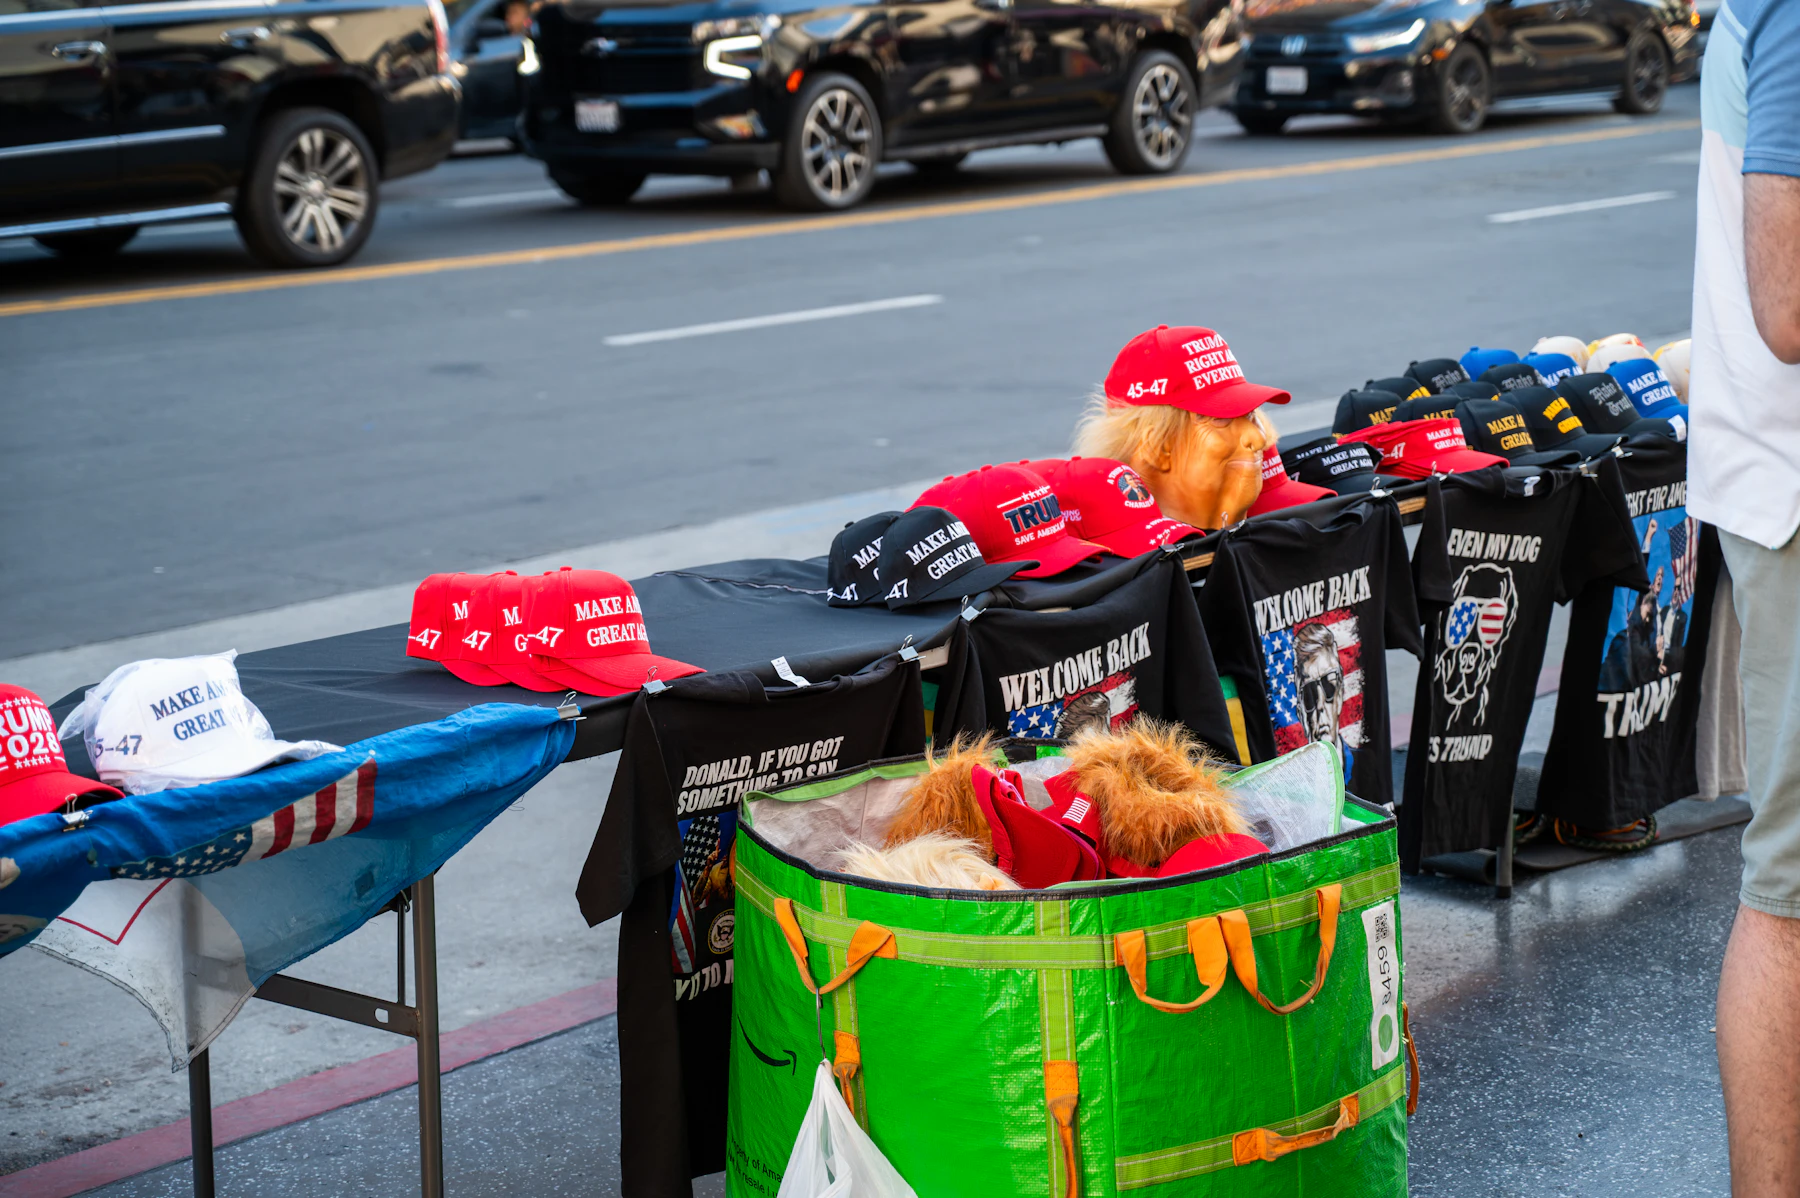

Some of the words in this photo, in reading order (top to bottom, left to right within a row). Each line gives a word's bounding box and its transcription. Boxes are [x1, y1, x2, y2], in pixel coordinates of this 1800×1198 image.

[1184, 350, 1226, 374] RIGHT
[1127, 378, 1168, 399] 45-47
[1627, 373, 1657, 394] MAKE
[1641, 385, 1671, 406] GREAT
[1426, 429, 1452, 441] MAKE
[1487, 415, 1518, 435] MAKE
[1434, 438, 1459, 450] GREAT
[1501, 432, 1527, 450] GREAT
[1321, 451, 1349, 466] MAKE
[1330, 460, 1359, 475] GREAT
[1646, 485, 1668, 513] FOR
[905, 528, 951, 566] MAKE
[1015, 532, 1035, 546] SAVE
[1447, 528, 1485, 559] EVEN
[1484, 533, 1511, 560] MY
[1508, 535, 1542, 563] DOG
[927, 546, 972, 580] GREAT
[574, 596, 623, 621] MAKE
[1253, 580, 1324, 636] WELCOME
[1327, 565, 1371, 611] BACK
[587, 622, 636, 647] GREAT
[999, 646, 1104, 713] WELCOME
[1106, 622, 1151, 676] BACK
[150, 685, 204, 721] MAKE
[1597, 672, 1682, 738] TRUMP
[173, 708, 227, 741] GREAT
[0, 731, 60, 763] 028
[1440, 734, 1493, 762] TRUMP
[682, 755, 753, 788] DONALD,
[757, 750, 776, 773] IF
[775, 742, 810, 769] YOU
[810, 736, 844, 760] GOT
[677, 776, 778, 815] SOMETHING
[1377, 945, 1392, 1006] 8459
[751, 1159, 761, 1171] of
